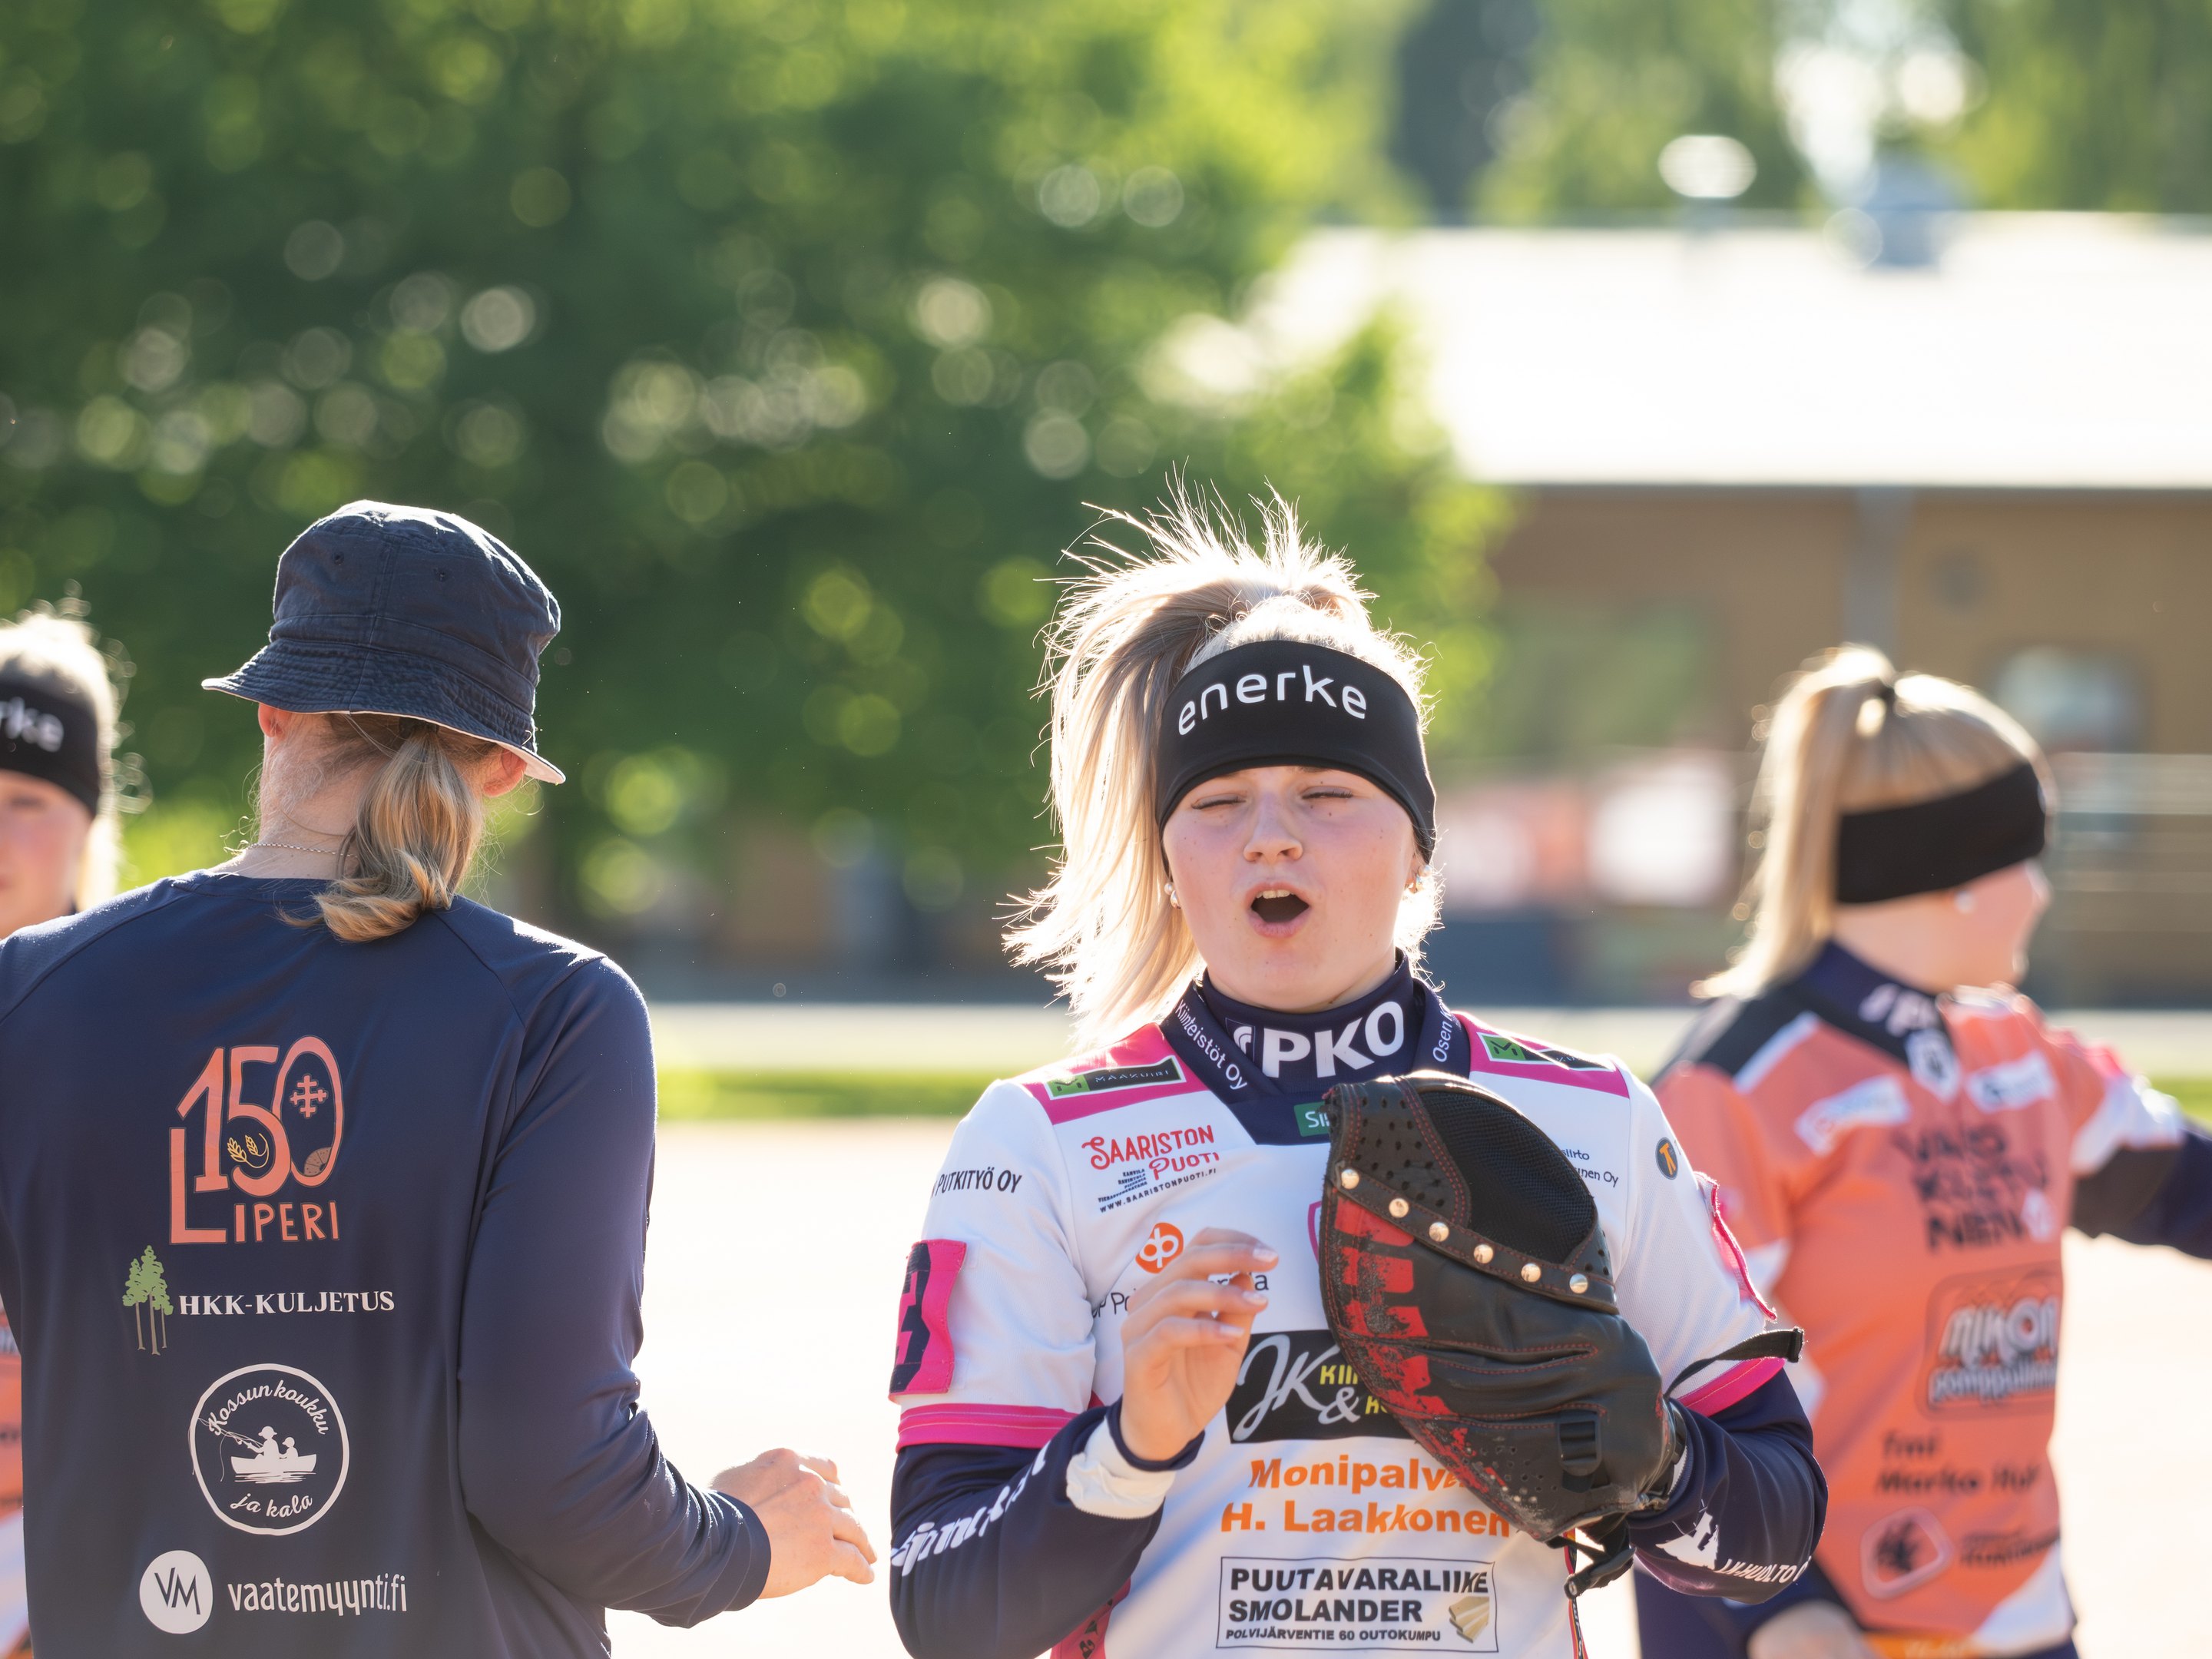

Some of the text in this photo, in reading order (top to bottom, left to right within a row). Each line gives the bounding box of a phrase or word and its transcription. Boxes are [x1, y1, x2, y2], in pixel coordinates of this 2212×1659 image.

[1178, 665, 1367, 736] enerke
[1175, 999, 1247, 1090] Kiinteistöt Oy
[1262, 1001, 1404, 1078] PKO
[1432, 1021, 1452, 1062] Osen
[177, 1035, 343, 1196] 150
[1081, 1124, 1214, 1171] SAARISTON
[1148, 1152, 1220, 1181] PUOTI
[171, 1127, 339, 1243] LIPERI
[935, 1166, 995, 1197] PUTKITYÖ
[1099, 1167, 1217, 1213] WWW.SAARISTONPUOTI.FI
[1603, 1171, 1619, 1188] Oy
[180, 1291, 395, 1315] HKK-KULJETUS
[208, 1379, 329, 1435] Kossun koukku
[230, 1493, 313, 1518] ja kala
[1221, 1500, 1510, 1538] H. Laakkonen
[154, 1567, 201, 1615] VM
[228, 1573, 407, 1616] vaatemyynti.fi
[1230, 1568, 1488, 1594] PUUTAVARALIIKE
[1229, 1598, 1422, 1623] SMOLANDER
[1226, 1626, 1441, 1642] POLVIJÄRVENTIE 60 OUTOKUMPU
